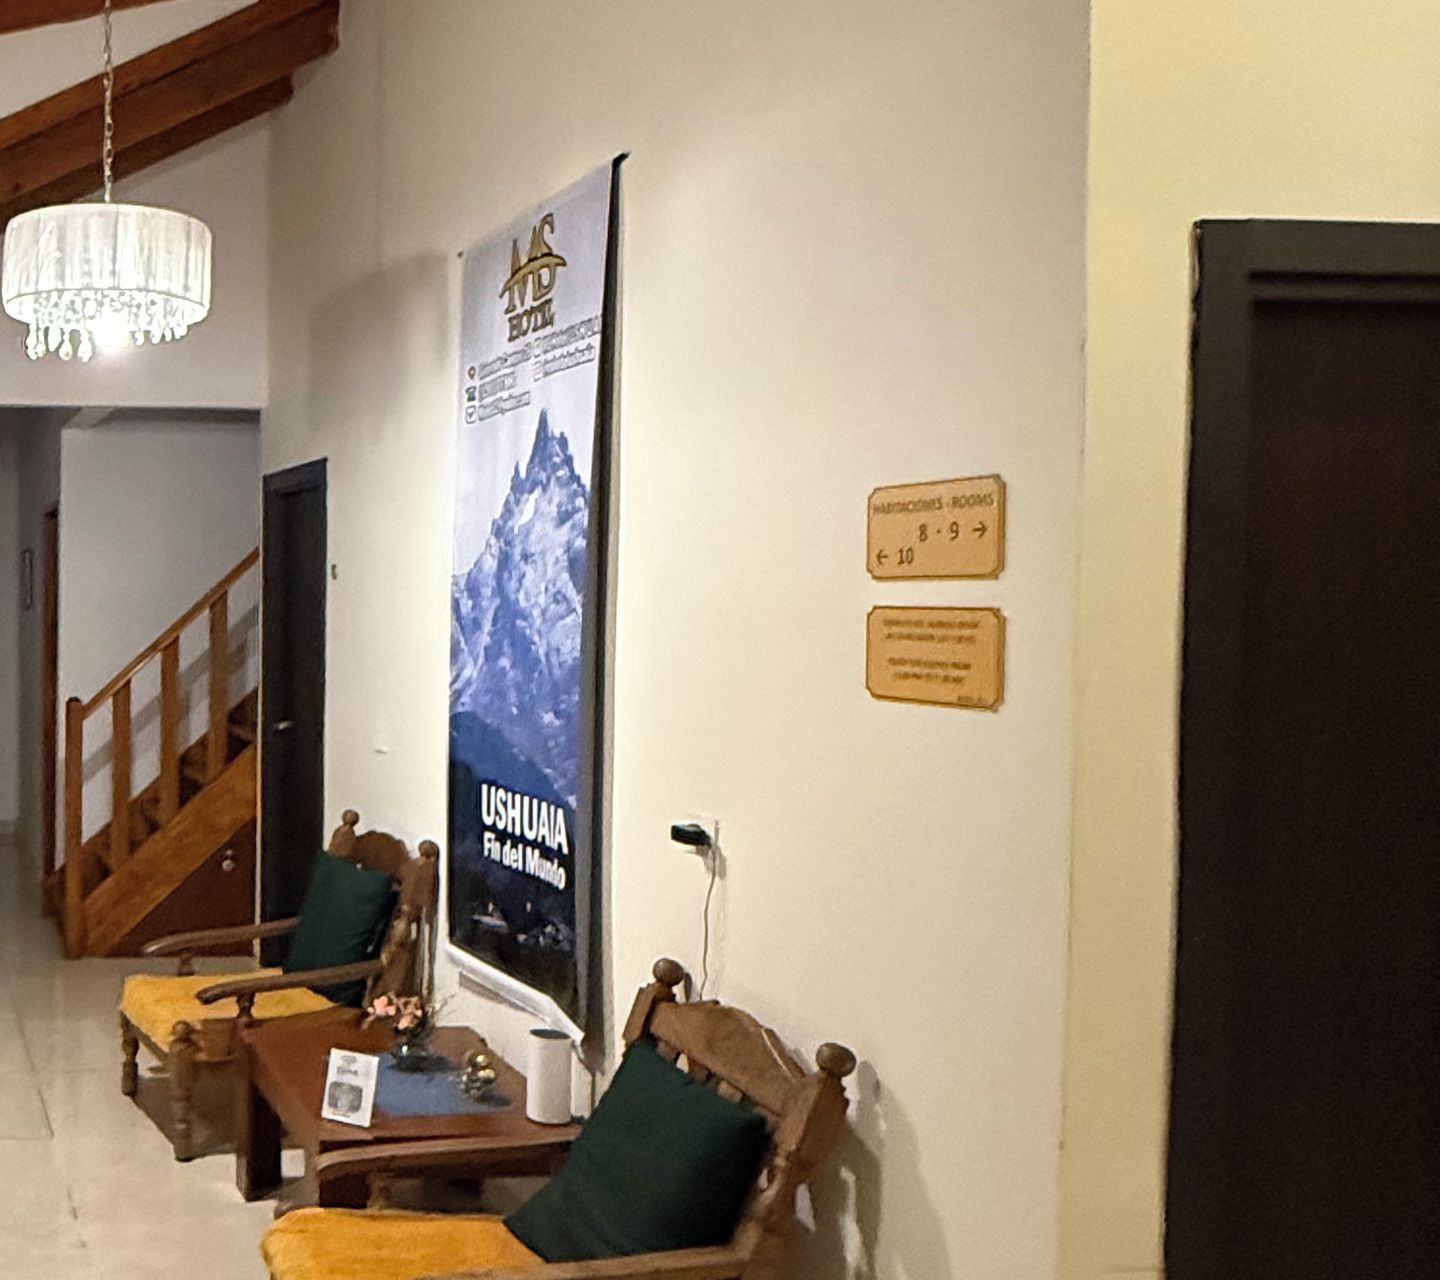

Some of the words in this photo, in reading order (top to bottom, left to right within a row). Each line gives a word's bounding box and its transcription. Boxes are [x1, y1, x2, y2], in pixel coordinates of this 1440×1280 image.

[951, 492, 994, 510] ROOMS
[919, 523, 929, 542] 8
[949, 521, 960, 542] 9
[897, 546, 915, 566] 10
[481, 783, 569, 855] USHUAIA
[483, 831, 501, 863] Fin
[502, 838, 523, 872] del
[525, 846, 567, 891] Mundo
